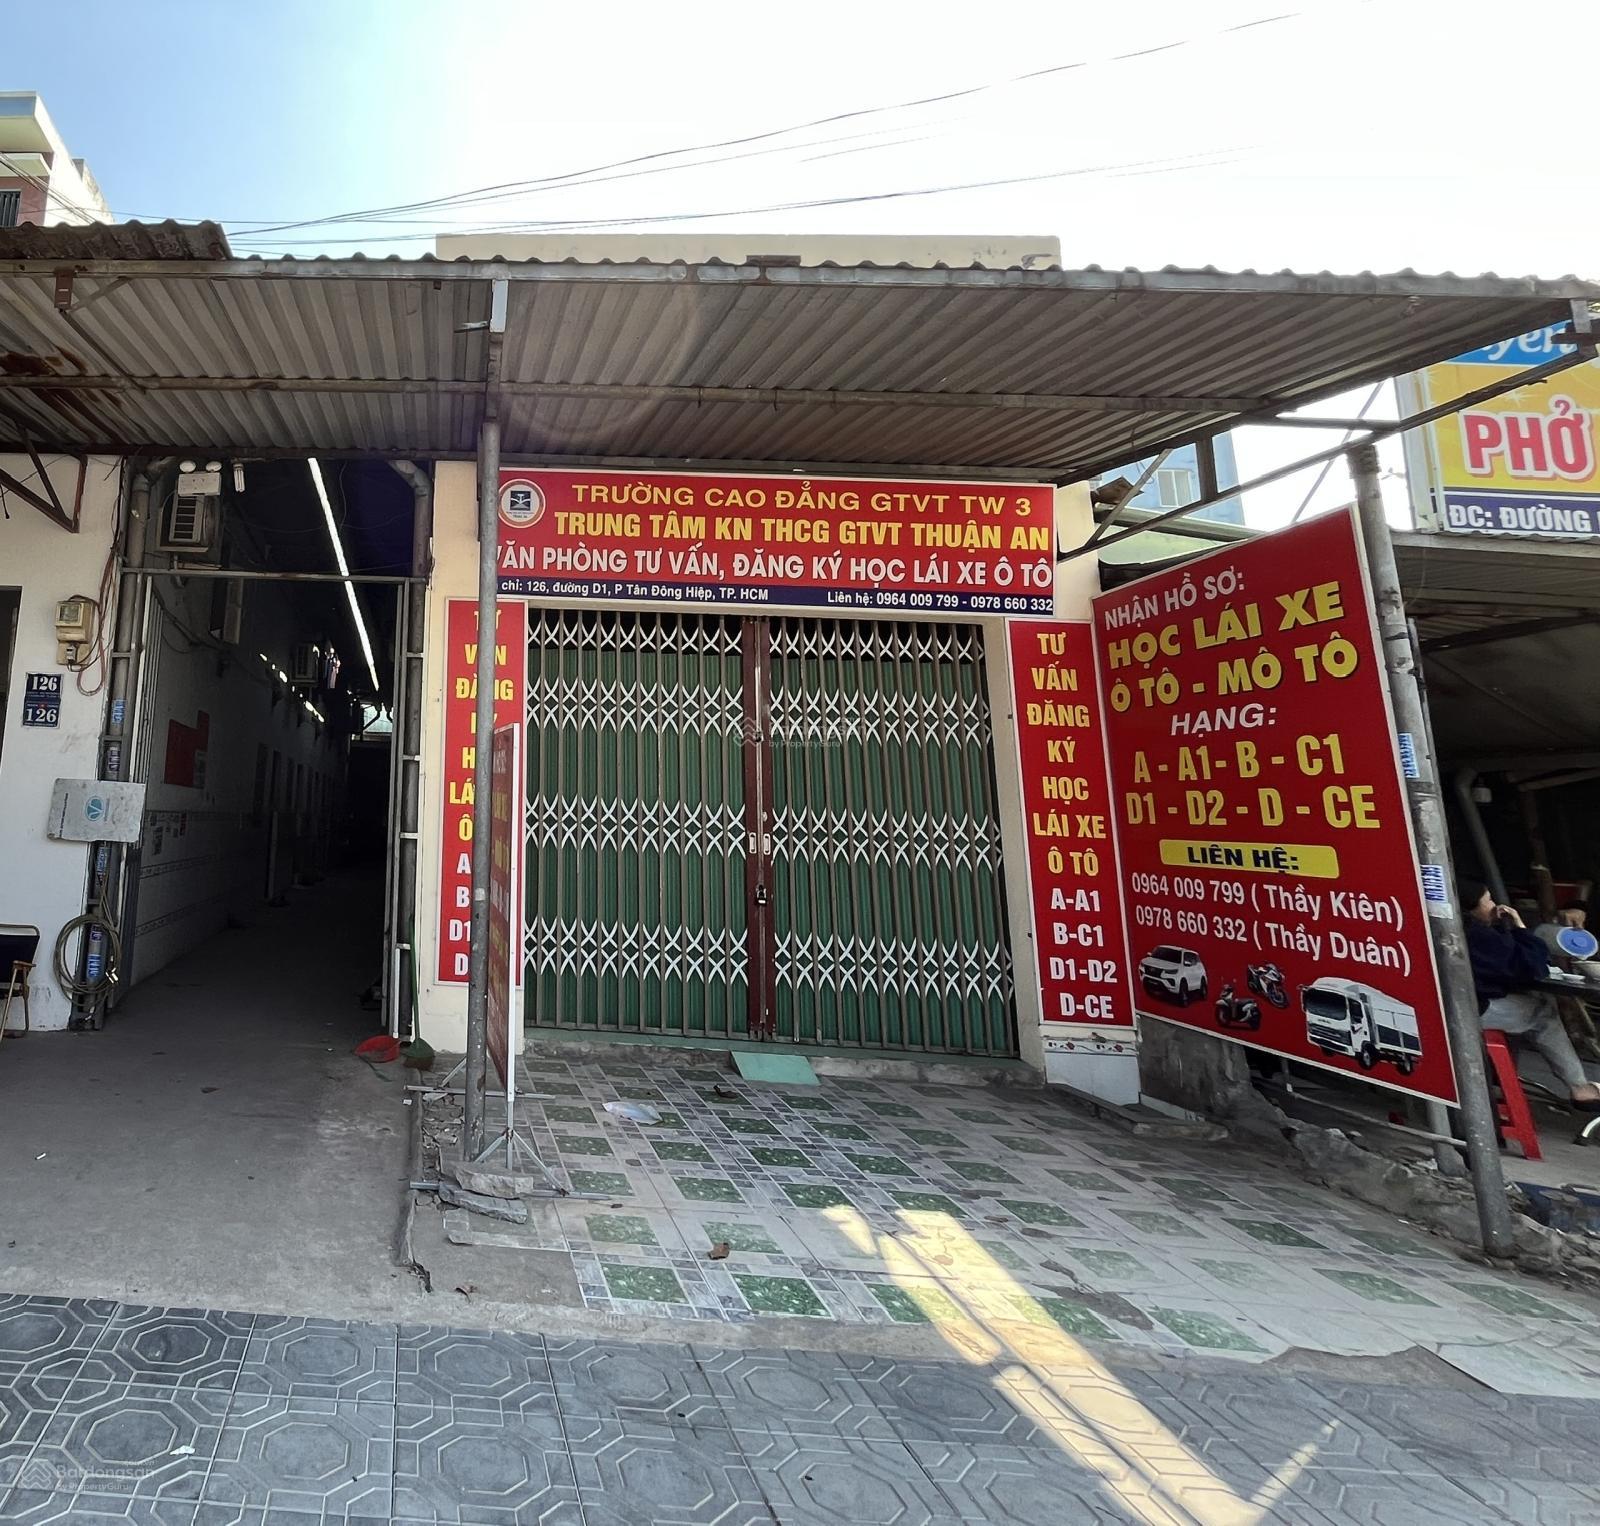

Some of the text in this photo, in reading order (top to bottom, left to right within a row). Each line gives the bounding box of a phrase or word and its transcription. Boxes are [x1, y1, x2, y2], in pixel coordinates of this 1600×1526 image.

[1461, 397, 1590, 476] PHỞ
[572, 481, 1031, 516] TRƯỜNG CAO ĐẲNG GTVT TW 3
[554, 510, 1049, 553] TRUNG TÂM KN THCG GTVT THUẬN AN
[1449, 504, 1493, 528] ĐC:
[1499, 504, 1592, 532] ĐƯỜNG
[542, 542, 628, 573] PHÒNG
[634, 547, 662, 574] TƯ
[668, 542, 725, 580] VẤN,
[733, 549, 804, 579] ĐĂNG
[812, 550, 842, 580] KÝ
[850, 558, 906, 588] HỌC
[913, 553, 949, 584] LÁI
[956, 561, 986, 585] XE
[993, 556, 1013, 587] Ô
[1021, 558, 1052, 588] TÔ
[502, 579, 523, 591] chỉ:
[527, 581, 549, 593] 126,
[553, 582, 589, 596] đường
[592, 584, 611, 596] D1,
[615, 584, 622, 594] P
[626, 584, 648, 596] Tân
[651, 585, 682, 601] Đông
[686, 586, 716, 603] Hiệp,
[719, 588, 736, 599] TP.
[740, 589, 768, 601] HCM
[827, 592, 852, 604] Liên
[855, 592, 873, 606] hệ:
[876, 593, 906, 606] 0964
[910, 594, 932, 607] 009
[936, 595, 959, 608] 799
[971, 596, 1001, 610] 0978
[1004, 597, 1027, 610] 660
[1030, 598, 1053, 611] 332
[1104, 566, 1245, 631] NHẬN HỒ SƠ:
[1108, 581, 1344, 670] HỌC LÁI XE
[1037, 632, 1066, 655] TƯ
[32, 676, 57, 691] 126
[1031, 661, 1078, 691] VẤN
[1110, 631, 1358, 713] Ô TÔ - MÔ TÔ
[26, 708, 57, 722] 126
[1026, 699, 1090, 728] ĐĂNG
[1171, 702, 1277, 738] HẠNG:
[1048, 736, 1076, 763] KÝ
[1134, 751, 1152, 783] A
[1235, 741, 1260, 778] B
[1296, 733, 1345, 776] C1
[1042, 776, 1089, 805] HỌC
[1126, 792, 1156, 825] D1
[1185, 790, 1228, 826] D2
[1258, 787, 1284, 827] D
[1322, 785, 1380, 829] CE
[1033, 808, 1106, 839] LÁI XE
[1048, 846, 1099, 876] Ô TÔ
[1187, 844, 1299, 873] LIÊN HỆ:
[1051, 888, 1100, 912] A-A1
[1132, 872, 1169, 896] 0964
[1174, 877, 1205, 900] 009
[1209, 880, 1245, 905] 799
[1330, 890, 1404, 932] Kiên)
[1053, 922, 1104, 947] B-C1
[1136, 905, 1173, 929] 0978
[1177, 910, 1208, 936] 660
[1213, 917, 1248, 942] 332
[1330, 932, 1411, 977] Duân)
[1060, 993, 1114, 1019] D-CE
